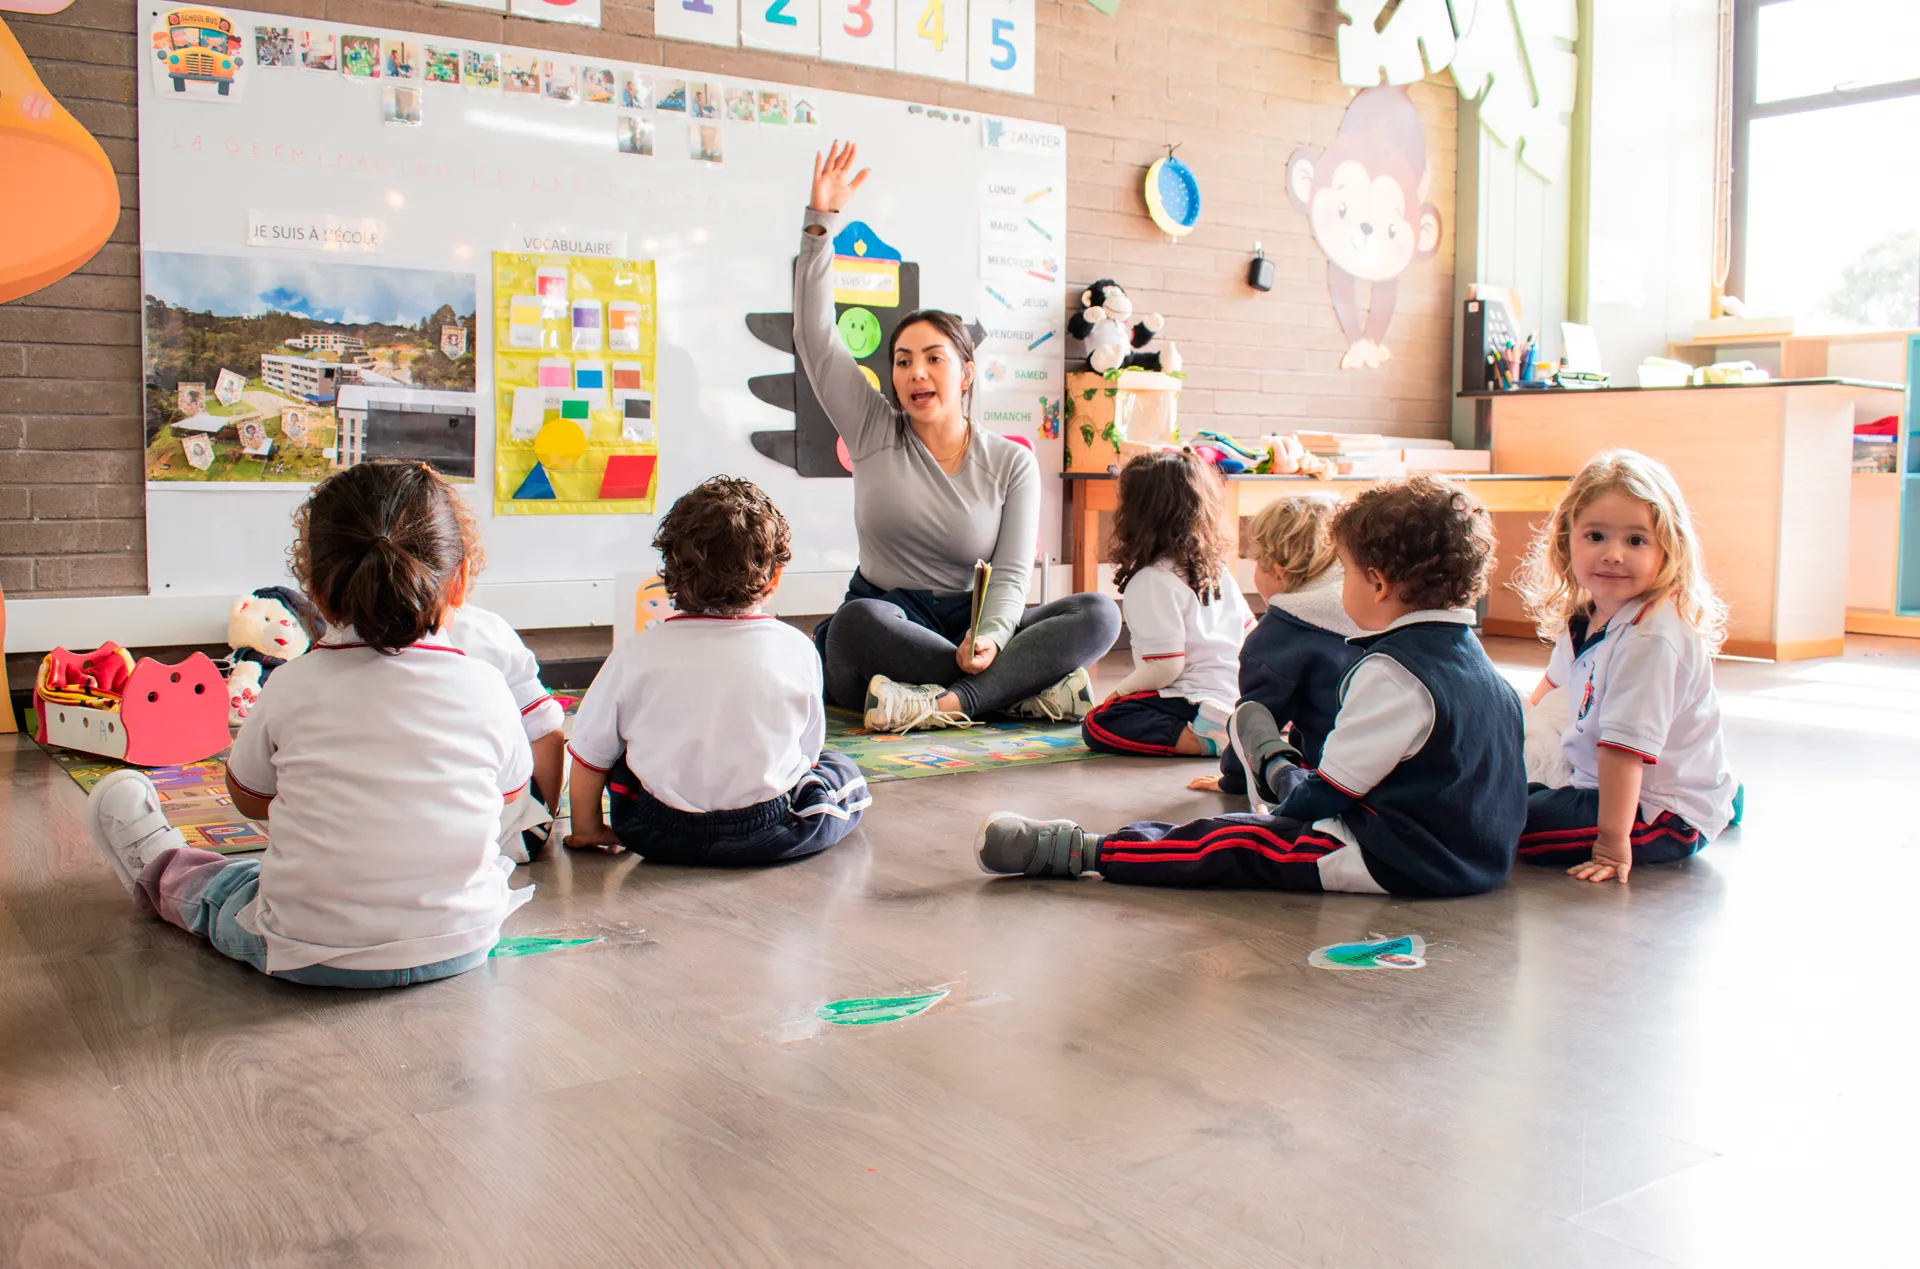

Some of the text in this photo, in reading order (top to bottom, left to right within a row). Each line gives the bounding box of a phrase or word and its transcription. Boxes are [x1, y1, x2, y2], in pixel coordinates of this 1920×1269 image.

[180, 14, 218, 26] SCHOOL BUS
[843, 0, 873, 38] 3
[916, 0, 948, 51] 4
[989, 18, 1017, 71] 5
[988, 184, 1016, 196] LUNDI
[253, 224, 268, 238] JE
[272, 225, 305, 241] SUIS
[308, 225, 319, 241] À
[990, 220, 1019, 233] MARDI
[523, 237, 613, 255] VOCABULAIRE
[987, 255, 1035, 268] MERCREDI
[1022, 298, 1049, 308] JEUDI
[988, 329, 1034, 342] VENDREDI
[1015, 369, 1049, 381] SAMEDI
[983, 410, 1033, 423] DIMANCHE
